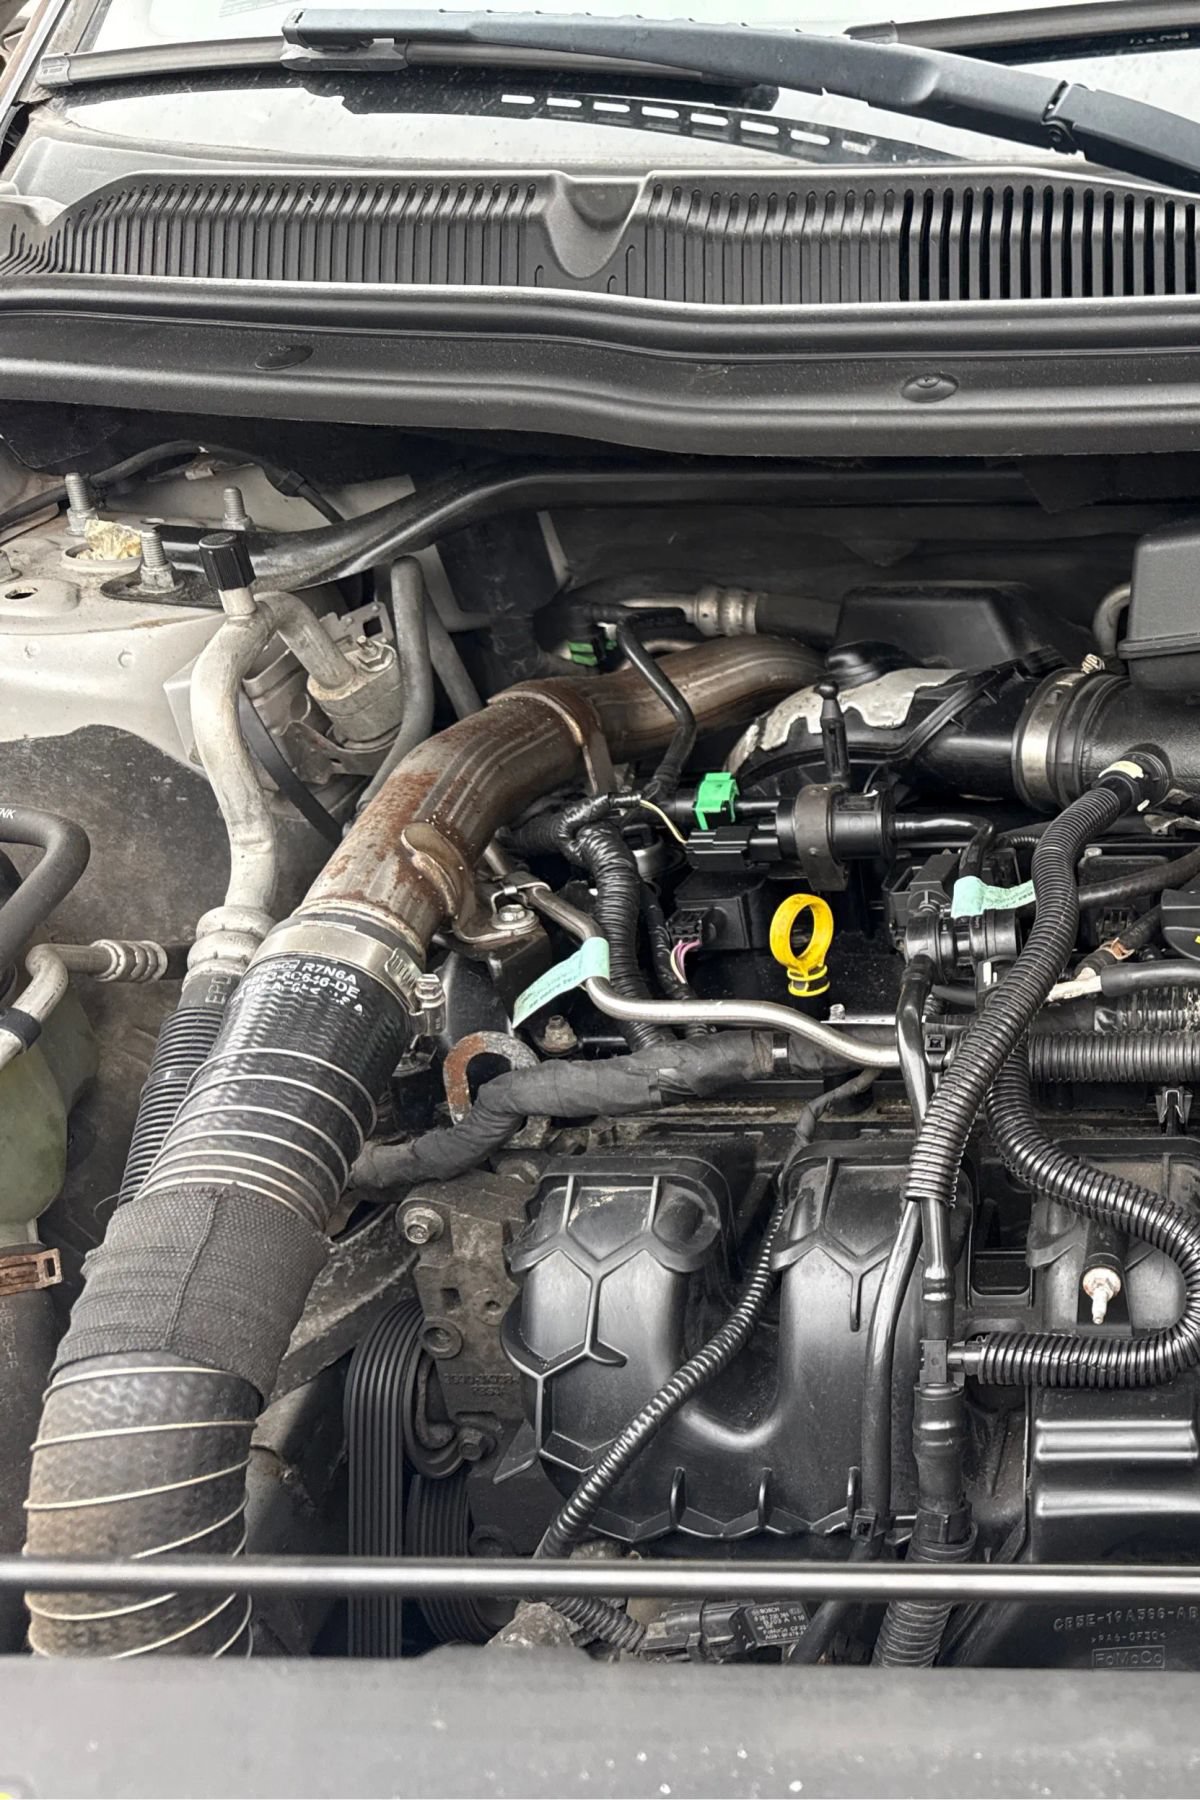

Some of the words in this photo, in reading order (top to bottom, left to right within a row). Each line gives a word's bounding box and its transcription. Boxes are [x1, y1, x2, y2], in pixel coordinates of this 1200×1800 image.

[0, 807, 17, 820] NK
[302, 962, 357, 985] R7N6A
[1095, 1649, 1164, 1666] FoMoCo
